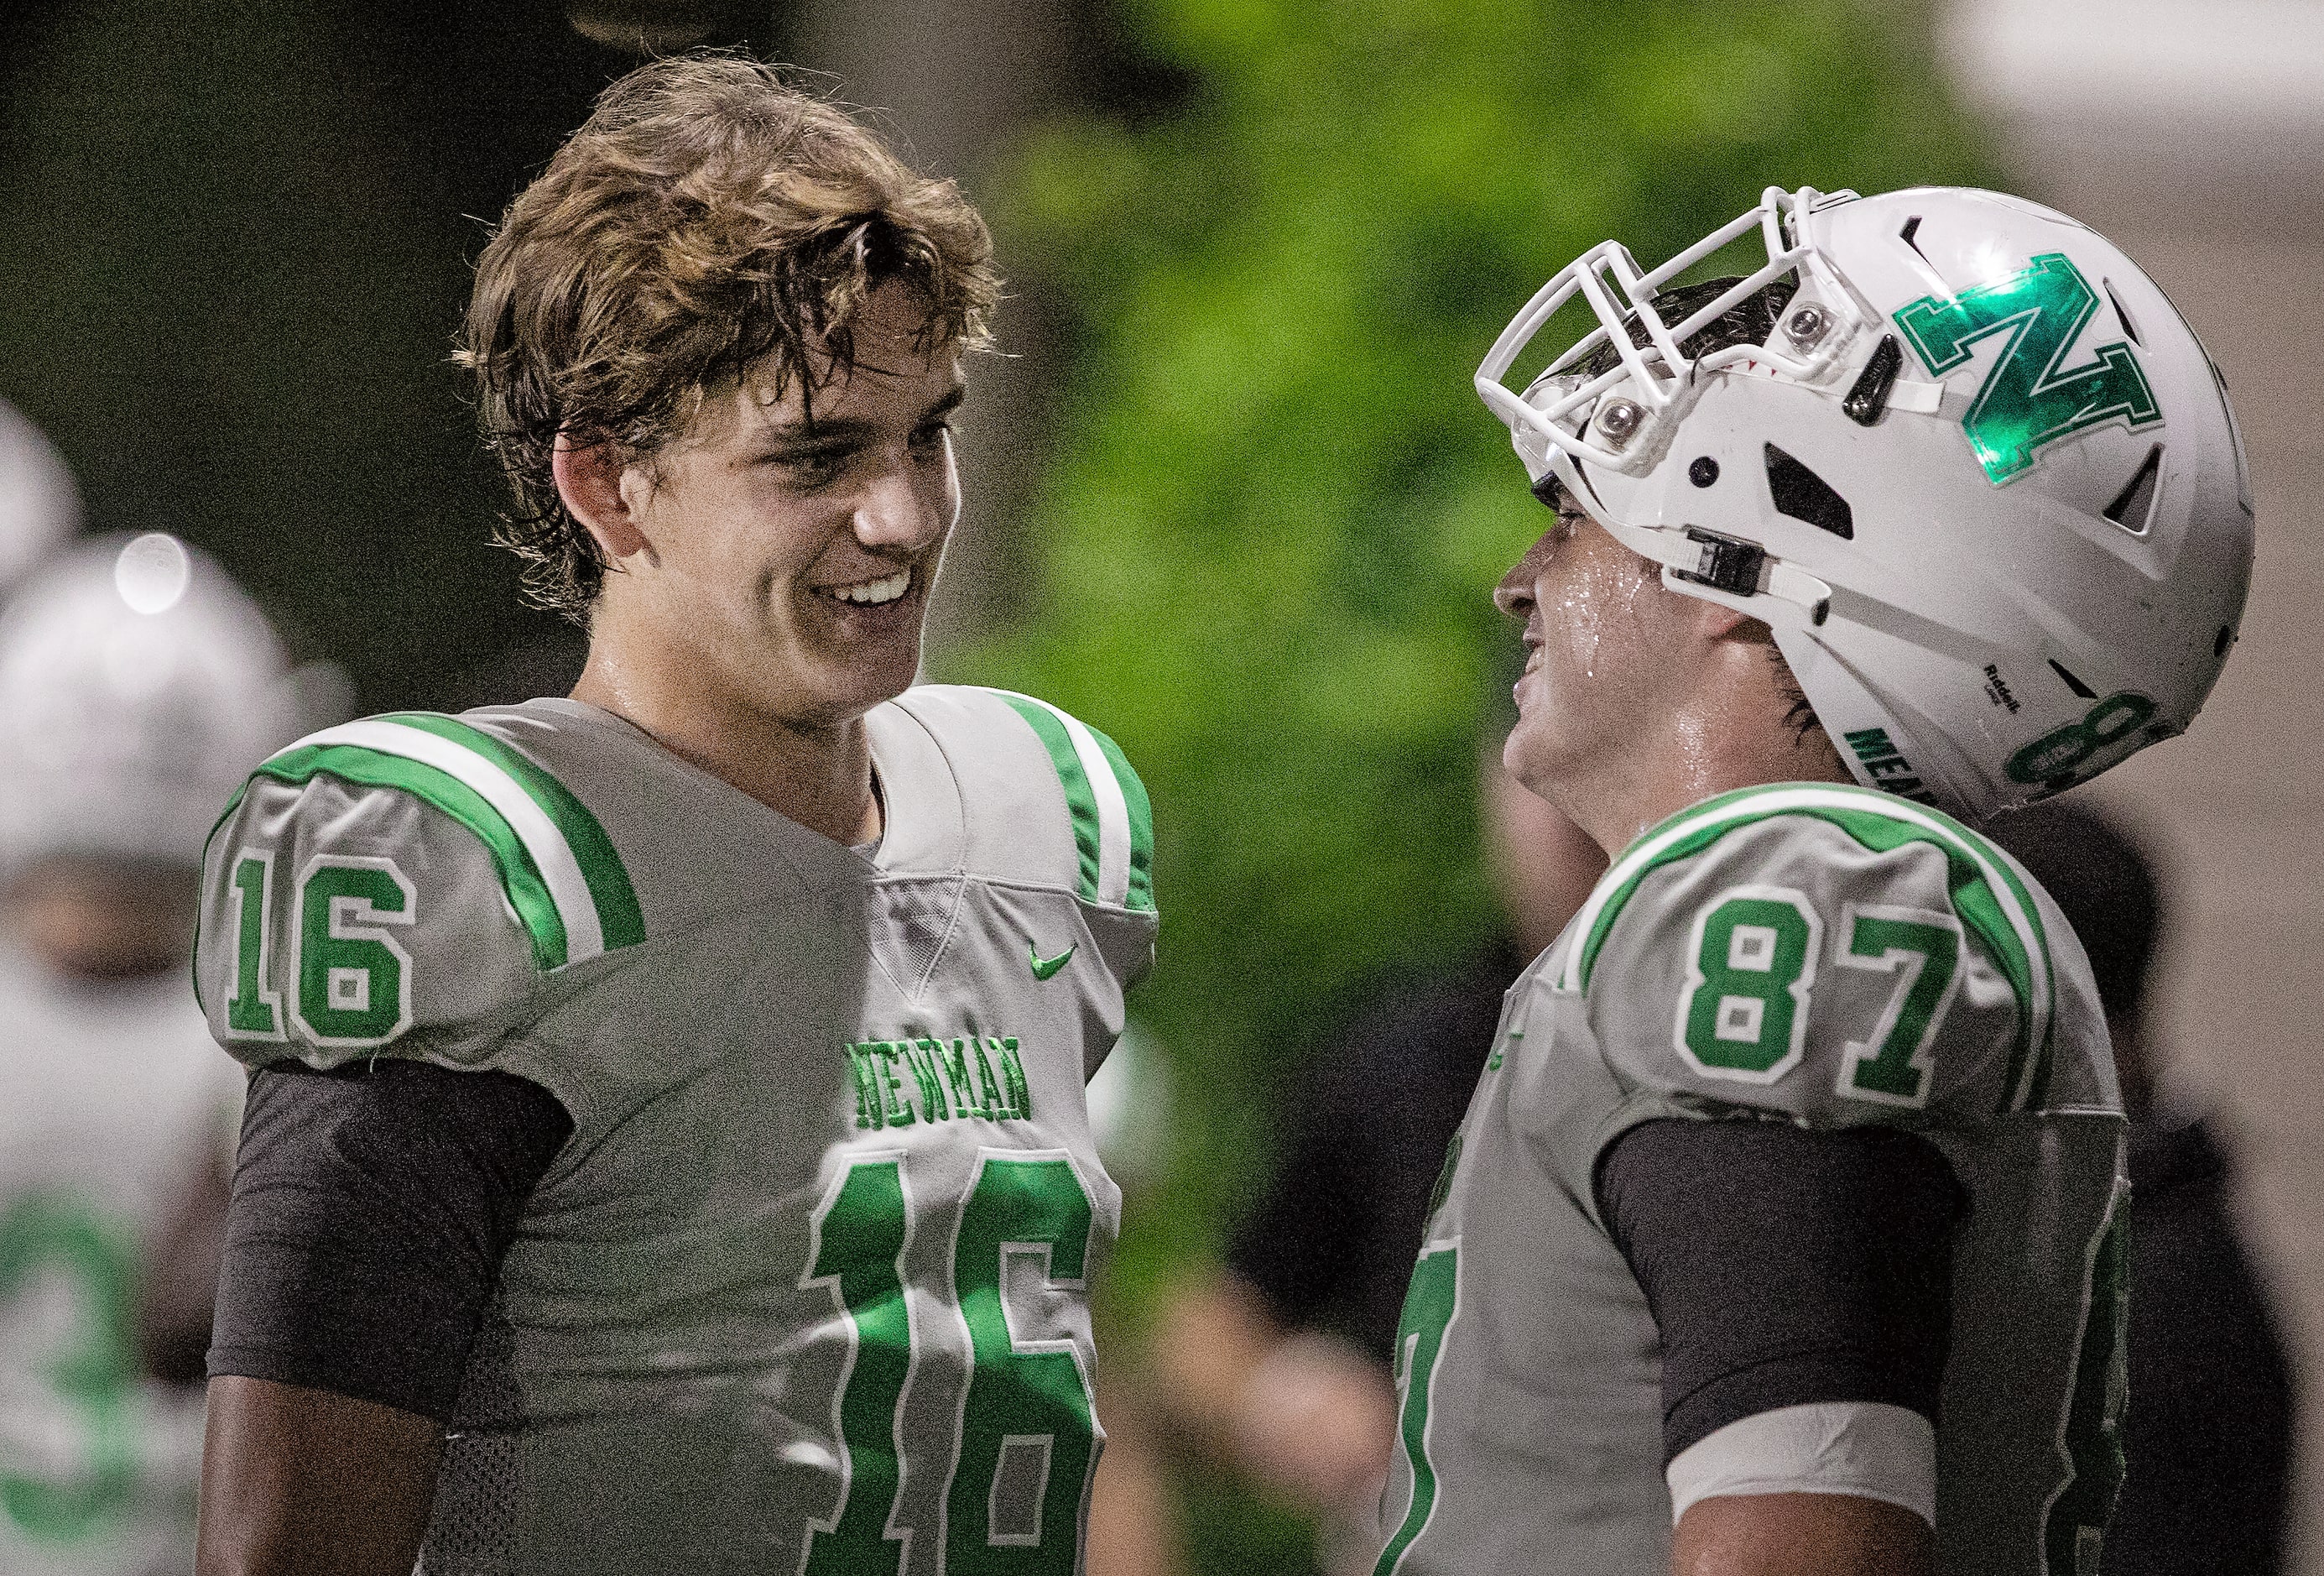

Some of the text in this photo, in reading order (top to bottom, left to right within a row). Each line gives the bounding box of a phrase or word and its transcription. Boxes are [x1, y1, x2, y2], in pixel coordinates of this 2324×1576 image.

[1891, 252, 2165, 487] N
[1983, 664, 2020, 714] Riddell
[225, 847, 416, 1047] 16
[1675, 884, 1965, 1109] 87
[845, 1036, 1032, 1131] NEWMAN
[792, 1146, 1107, 1576] 16
